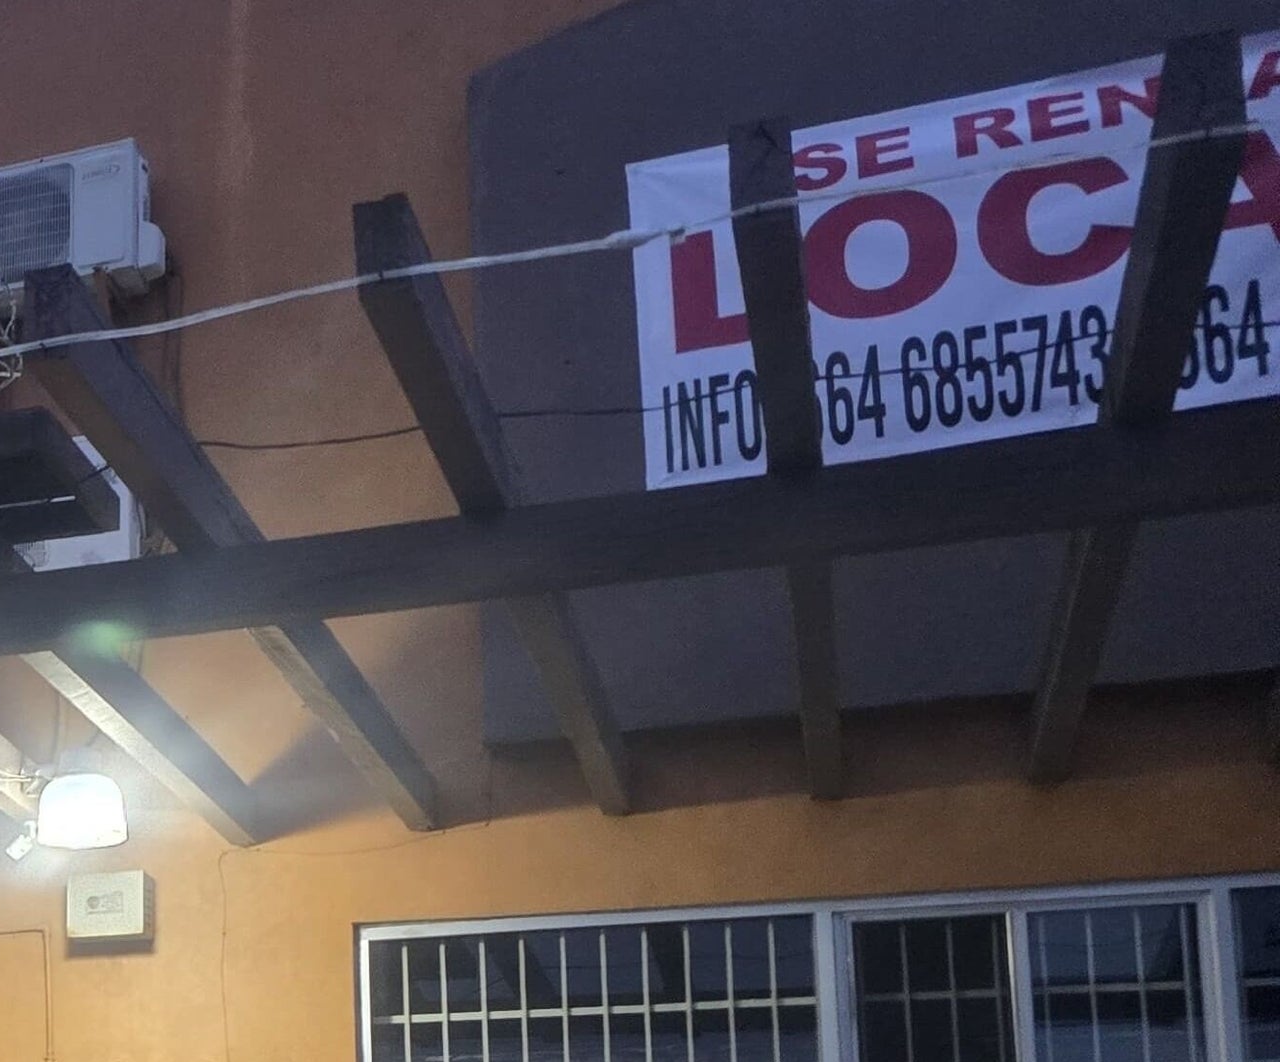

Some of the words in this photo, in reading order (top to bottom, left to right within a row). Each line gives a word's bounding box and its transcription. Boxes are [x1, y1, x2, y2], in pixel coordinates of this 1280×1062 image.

[793, 126, 915, 192] SE
[953, 48, 1280, 159] RENA
[662, 368, 763, 474] INFO
[811, 344, 887, 446] 64
